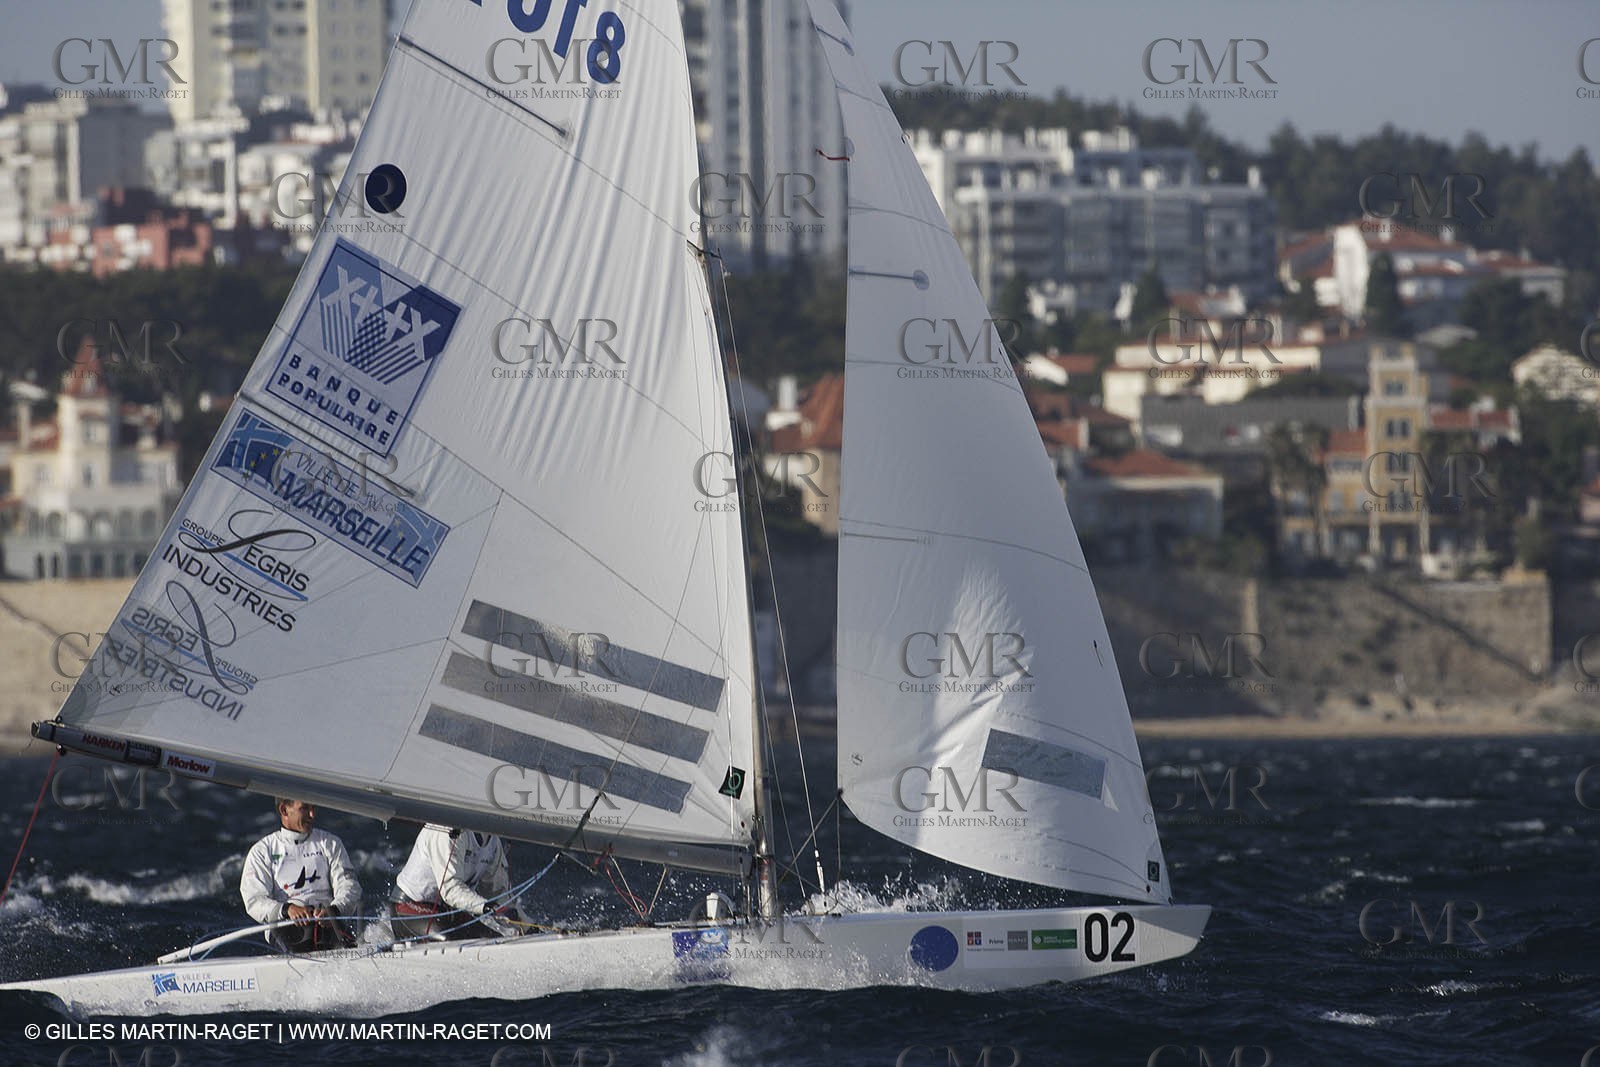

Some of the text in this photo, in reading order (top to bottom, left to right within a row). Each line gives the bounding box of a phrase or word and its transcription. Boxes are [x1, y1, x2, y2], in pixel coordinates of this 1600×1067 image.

[289, 354, 399, 426] BANQUE
[182, 518, 226, 547] GROUPE
[273, 465, 430, 575] MARSEILLE
[162, 543, 297, 633] INDUSTRIES
[166, 754, 212, 774] Marlow
[1083, 911, 1136, 963] 02
[183, 978, 256, 994] MARSEILLE
